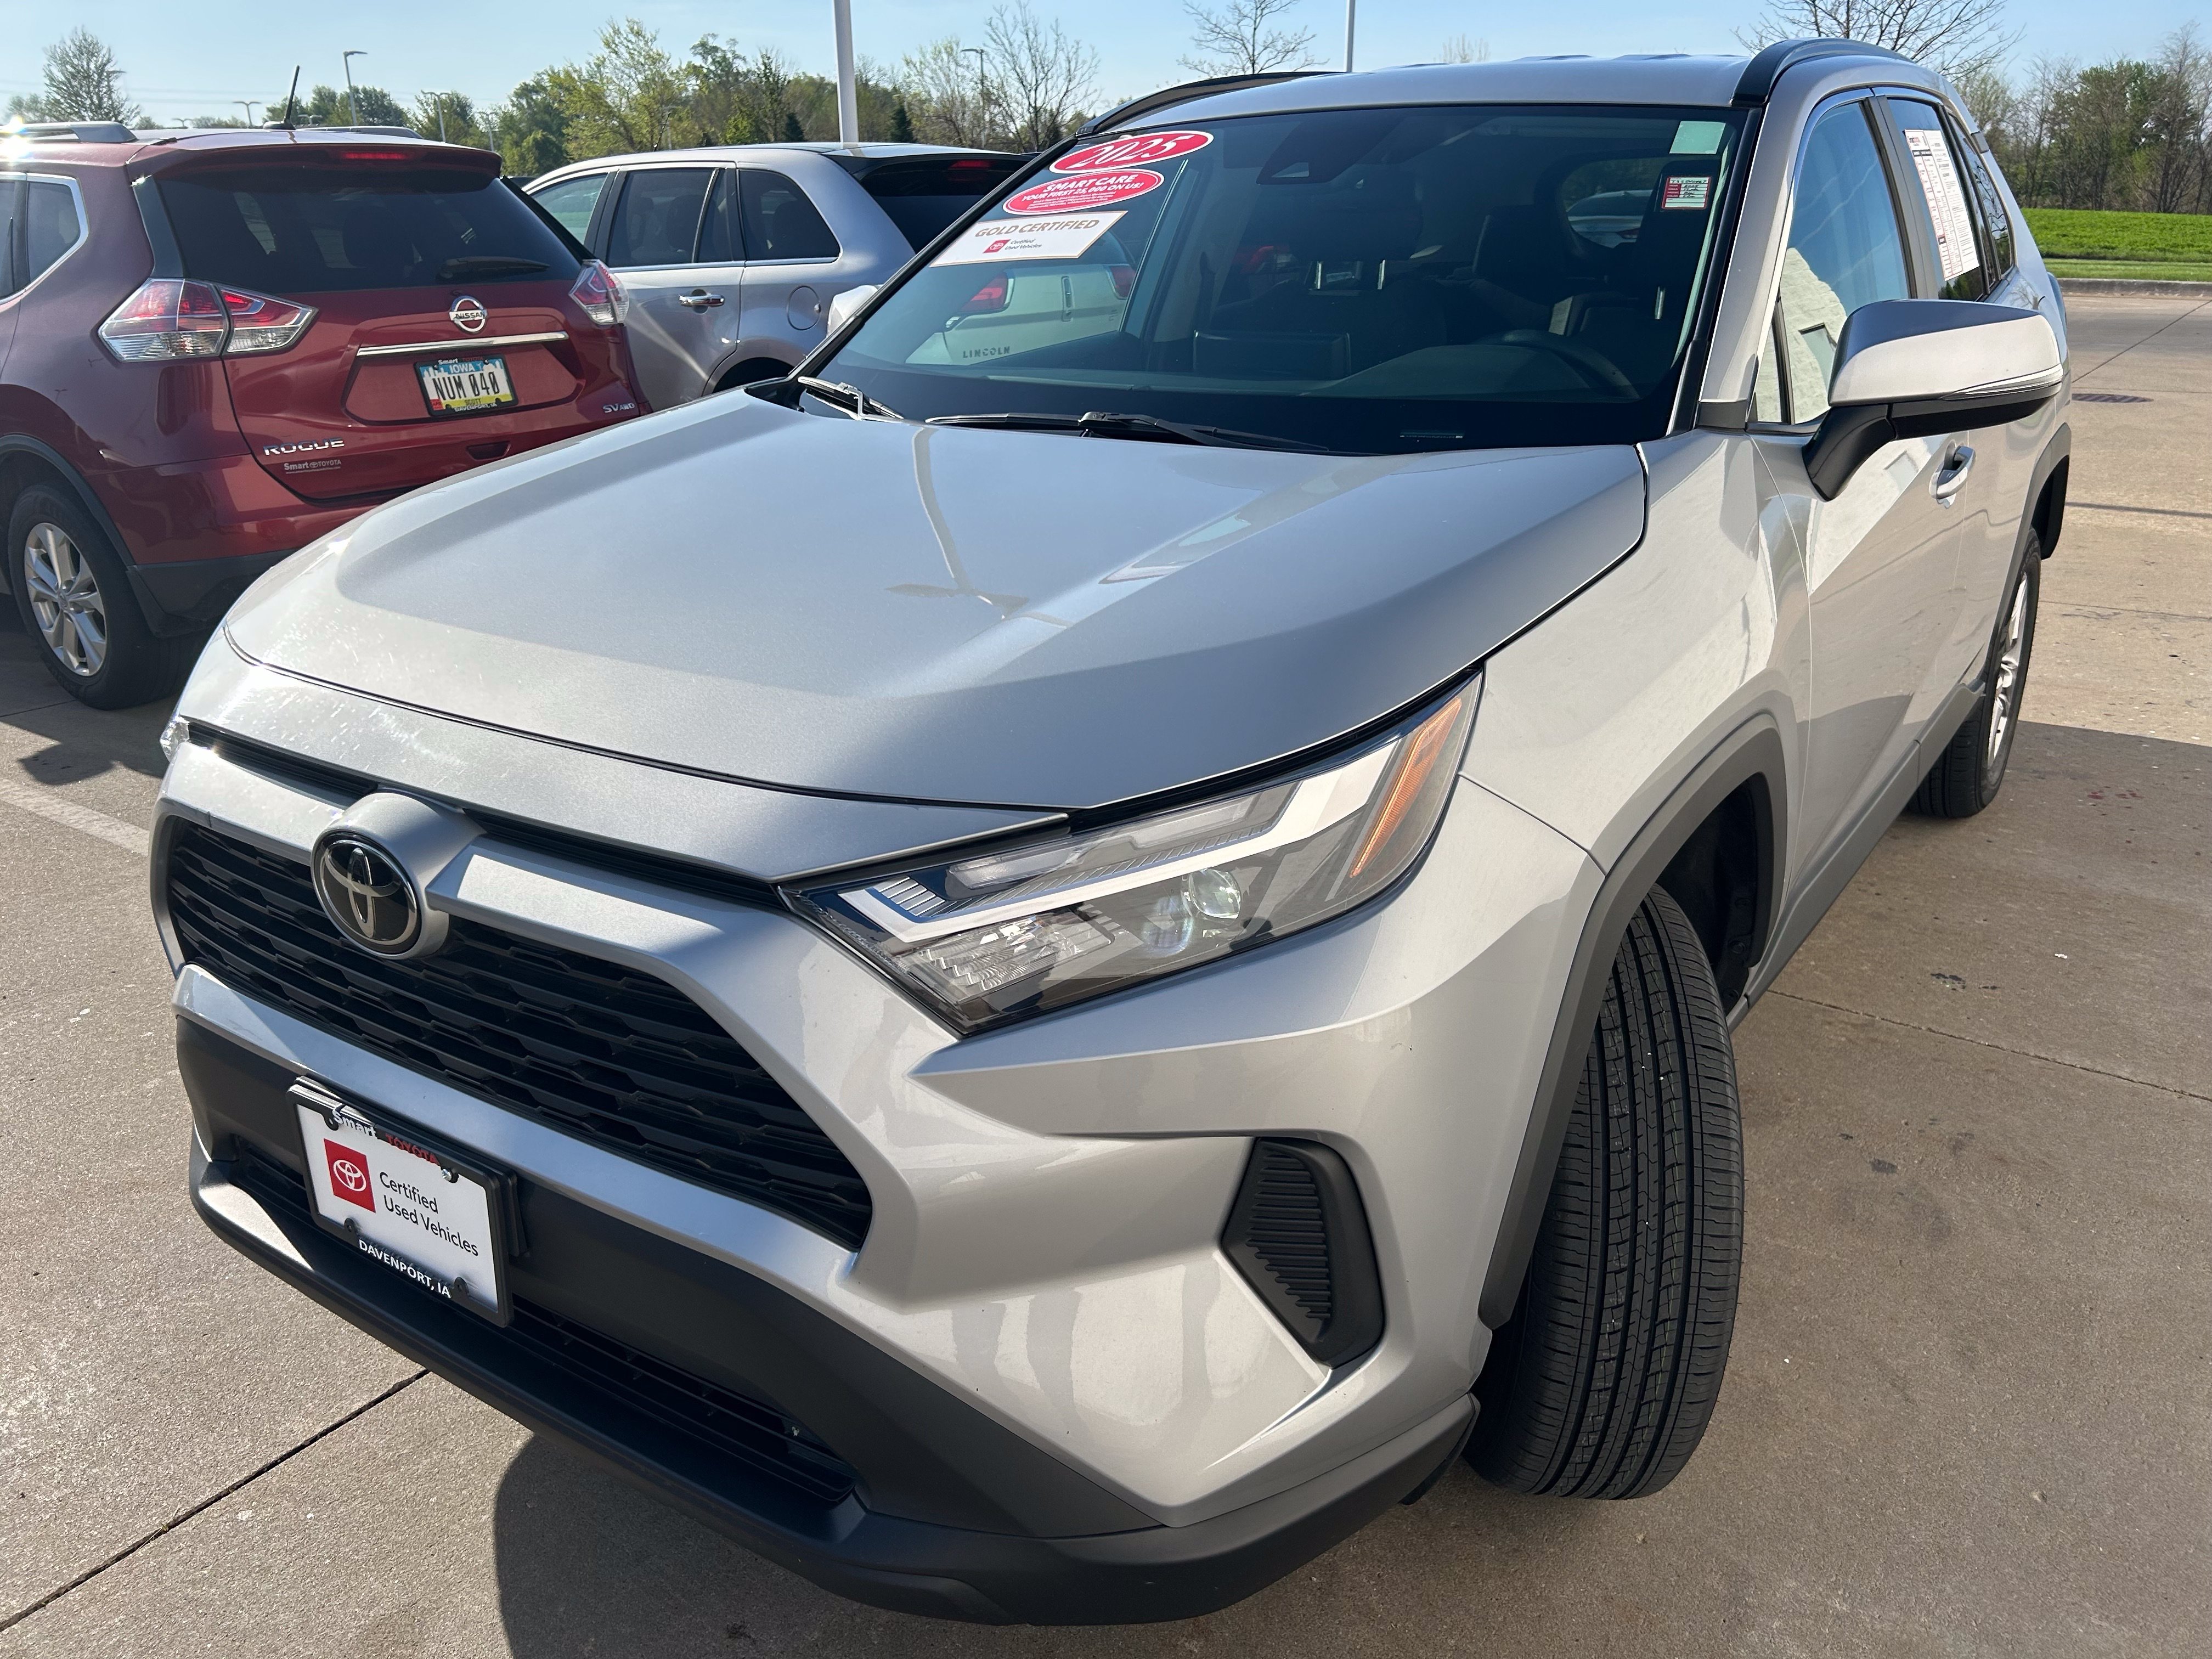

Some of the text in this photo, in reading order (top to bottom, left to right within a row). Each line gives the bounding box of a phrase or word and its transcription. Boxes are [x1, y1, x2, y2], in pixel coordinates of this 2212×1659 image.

[1065, 134, 1195, 169] 2025
[1043, 174, 1139, 193] SMART CARE
[1021, 191, 1048, 202] YOUR
[1046, 189, 1076, 199] FIRST
[975, 219, 1100, 238] GOLD CERTIFIED
[963, 346, 1011, 358] LINCOLN
[449, 363, 476, 374] IOWA
[432, 372, 500, 400] NUM 040
[603, 403, 619, 413] SV
[263, 437, 345, 456] ROGUE
[284, 461, 309, 471] Smart
[332, 1110, 439, 1164] Smart TOYOTA
[380, 1171, 438, 1214] Certified
[383, 1195, 479, 1256] Used Vehicles
[359, 1239, 452, 1299] DAVENPORT, IA
